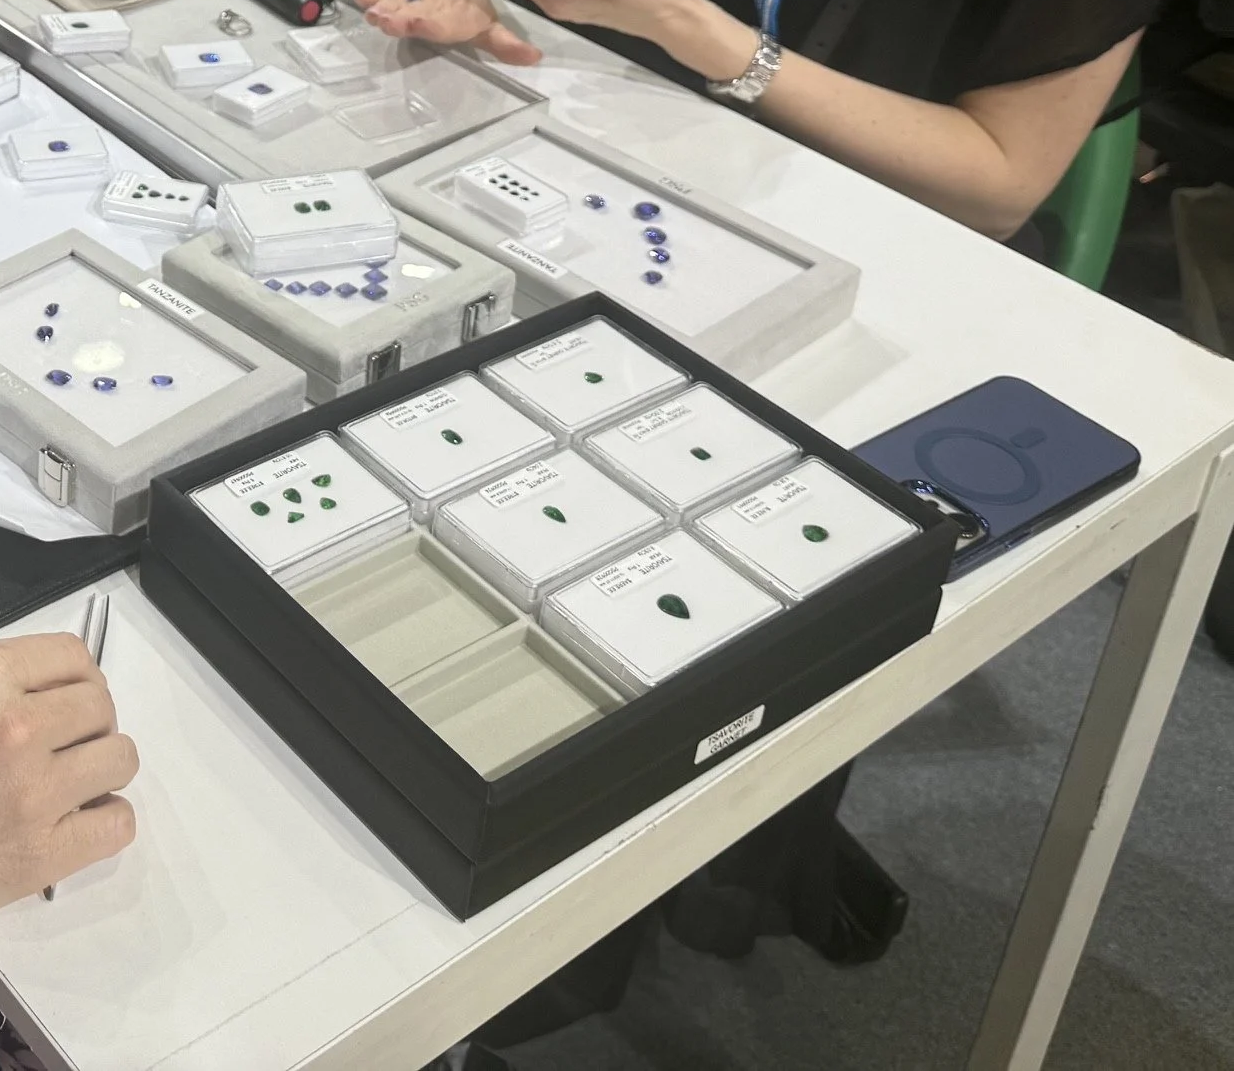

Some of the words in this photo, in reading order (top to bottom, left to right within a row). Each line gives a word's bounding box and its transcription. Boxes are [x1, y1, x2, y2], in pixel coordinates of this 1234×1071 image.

[506, 242, 558, 273] TANZANITE
[147, 283, 196, 314] TANZANITE
[272, 461, 307, 479] TSAVORITE
[526, 472, 559, 489] TSAVORITE
[638, 555, 673, 575] TSAVORITE
[708, 711, 755, 747] TSAVORITE
[710, 726, 747, 754] GARNET
